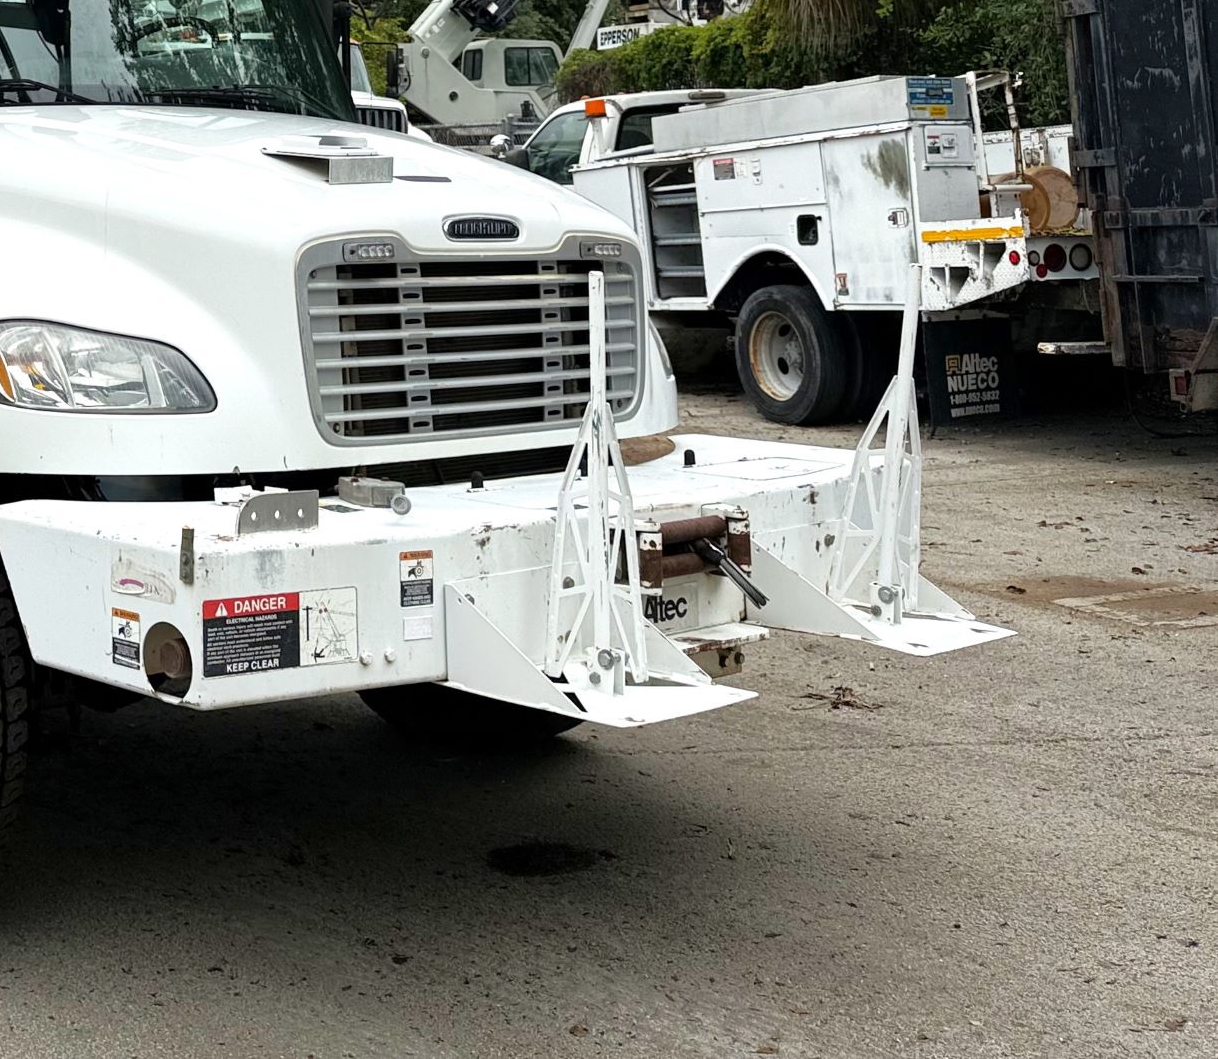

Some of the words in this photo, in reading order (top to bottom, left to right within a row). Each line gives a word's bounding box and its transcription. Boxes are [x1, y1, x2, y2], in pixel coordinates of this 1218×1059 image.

[600, 27, 640, 46] EPPERSON
[962, 353, 998, 374] Altec
[947, 371, 999, 392] NUECO
[234, 597, 286, 613] DANGER
[644, 595, 688, 623] Altec
[226, 617, 254, 625] ELECTRICAL
[226, 662, 249, 673] KEEP
[251, 659, 279, 670] CLEAR
